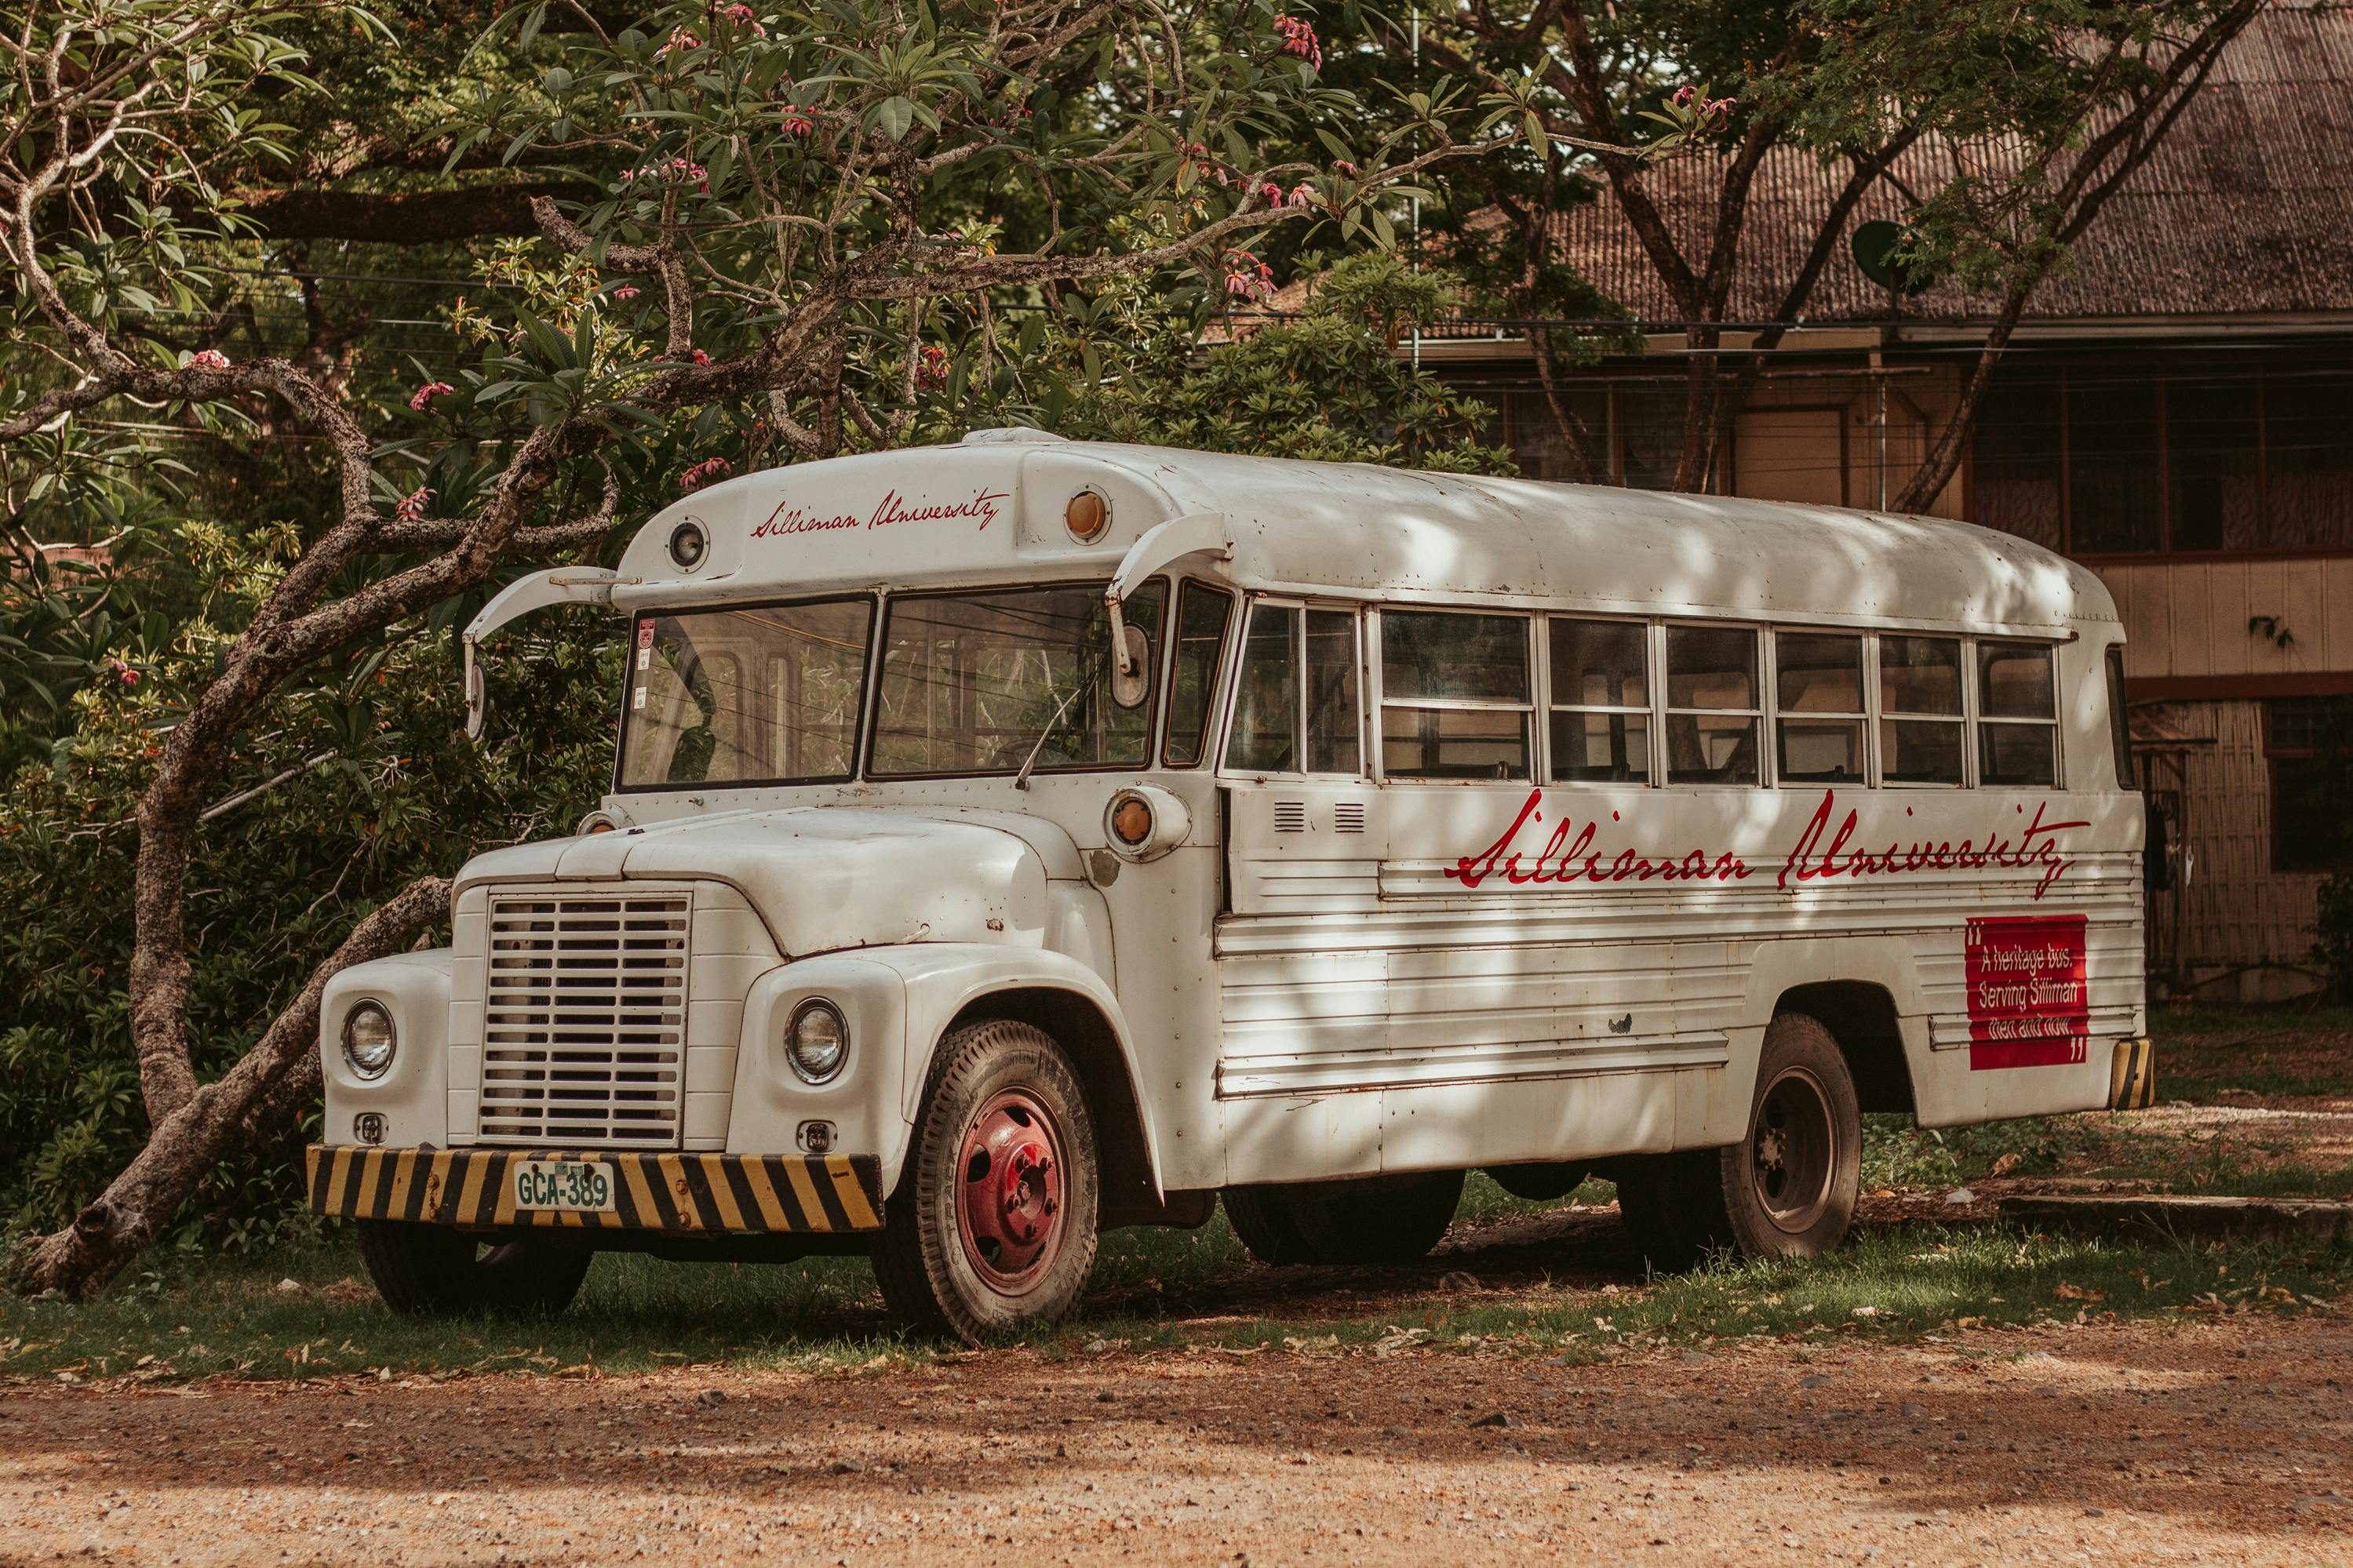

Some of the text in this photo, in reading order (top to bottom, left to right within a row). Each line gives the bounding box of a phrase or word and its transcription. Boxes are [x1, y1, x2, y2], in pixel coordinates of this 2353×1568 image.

[751, 487, 1010, 538] Silliman University
[1444, 788, 2091, 901] Silliman University
[1981, 942, 2073, 977] A heritage bus.
[1979, 977, 2078, 1013] Serving Silliman
[1988, 1013, 2074, 1040] then and now.
[518, 1172, 608, 1207] GCA-389
